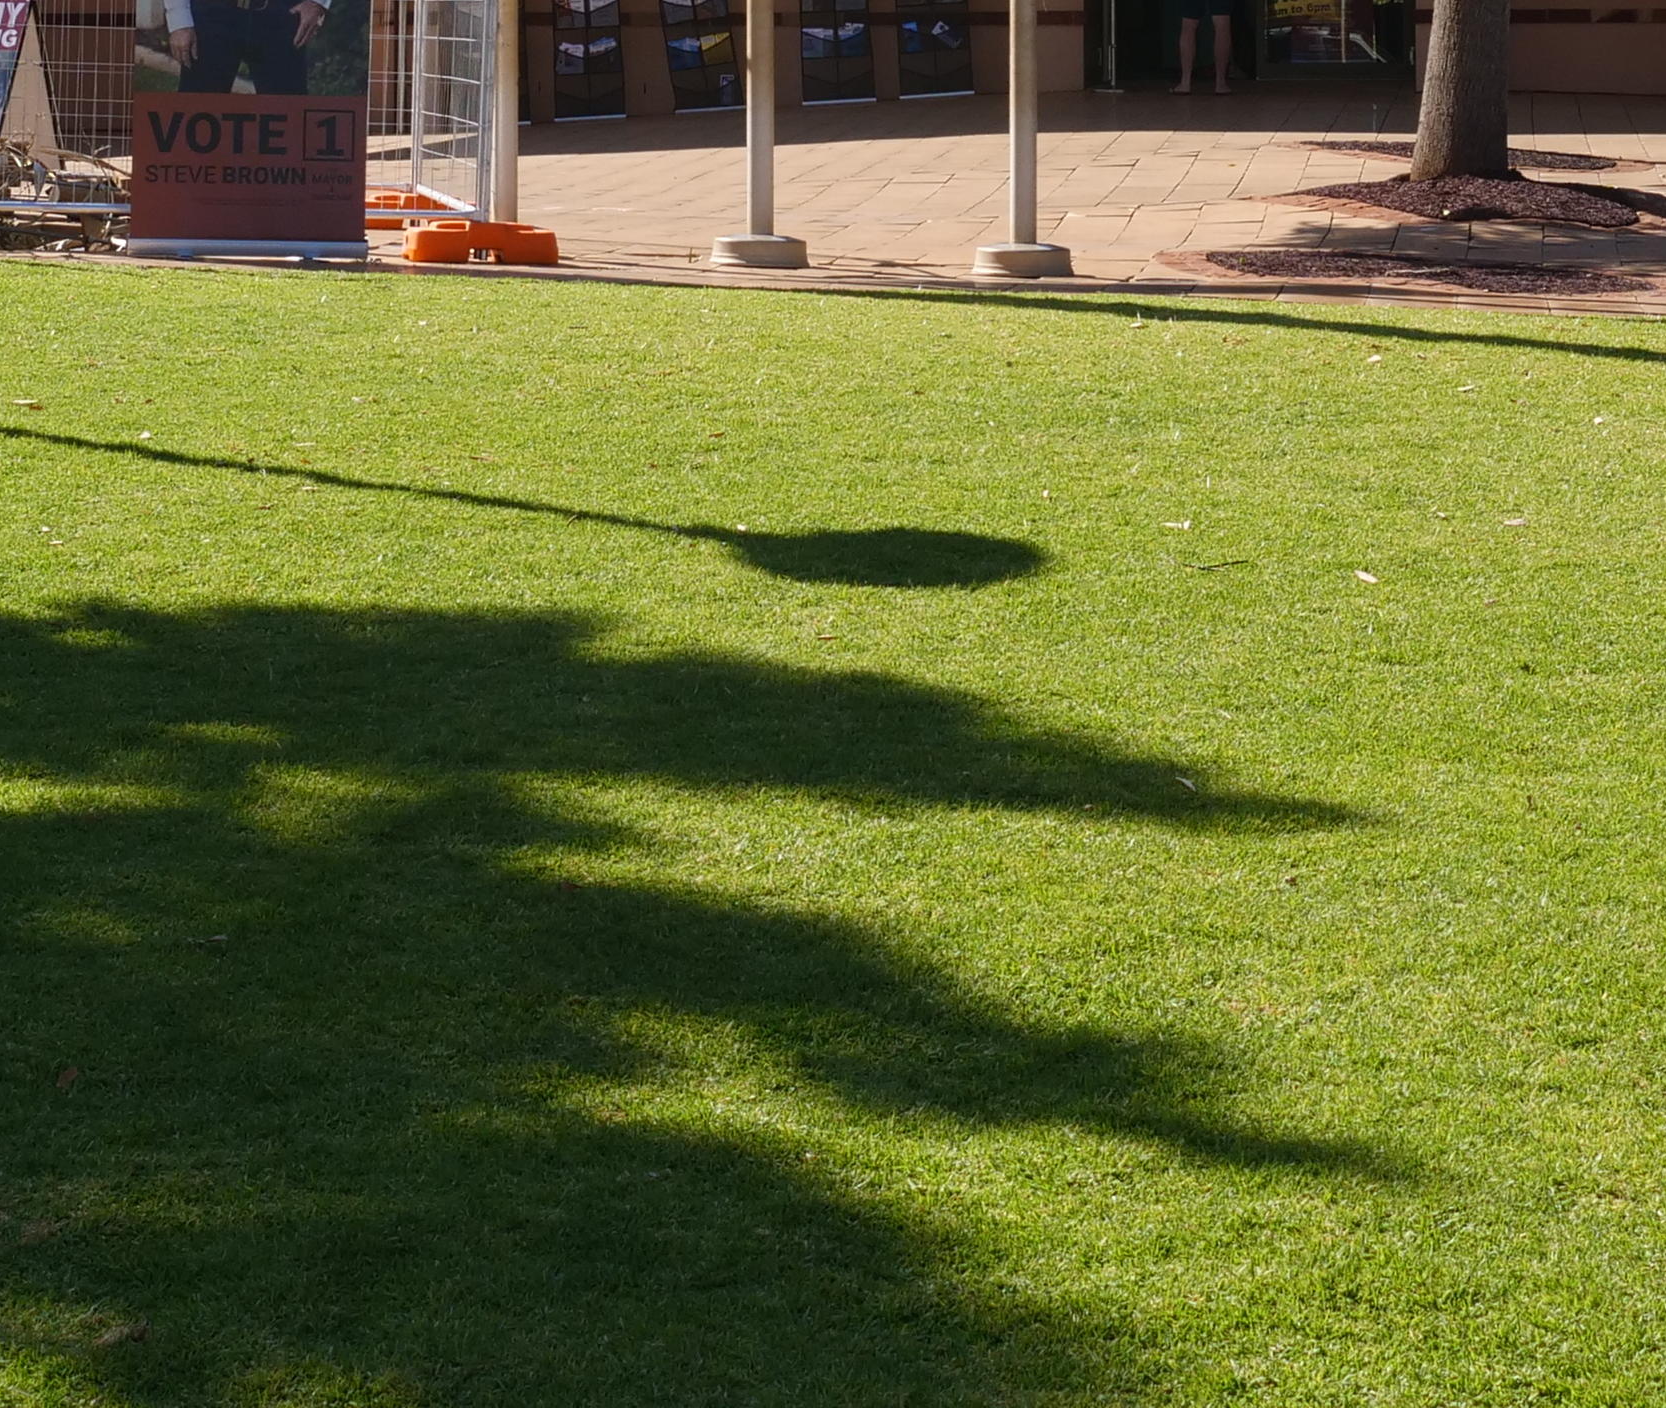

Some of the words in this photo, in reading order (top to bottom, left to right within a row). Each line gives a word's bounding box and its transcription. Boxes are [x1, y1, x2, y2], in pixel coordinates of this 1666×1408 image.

[147, 112, 288, 155] VOTE
[317, 116, 344, 156] 1
[145, 164, 217, 184] STEVE
[221, 166, 306, 185] BROWN
